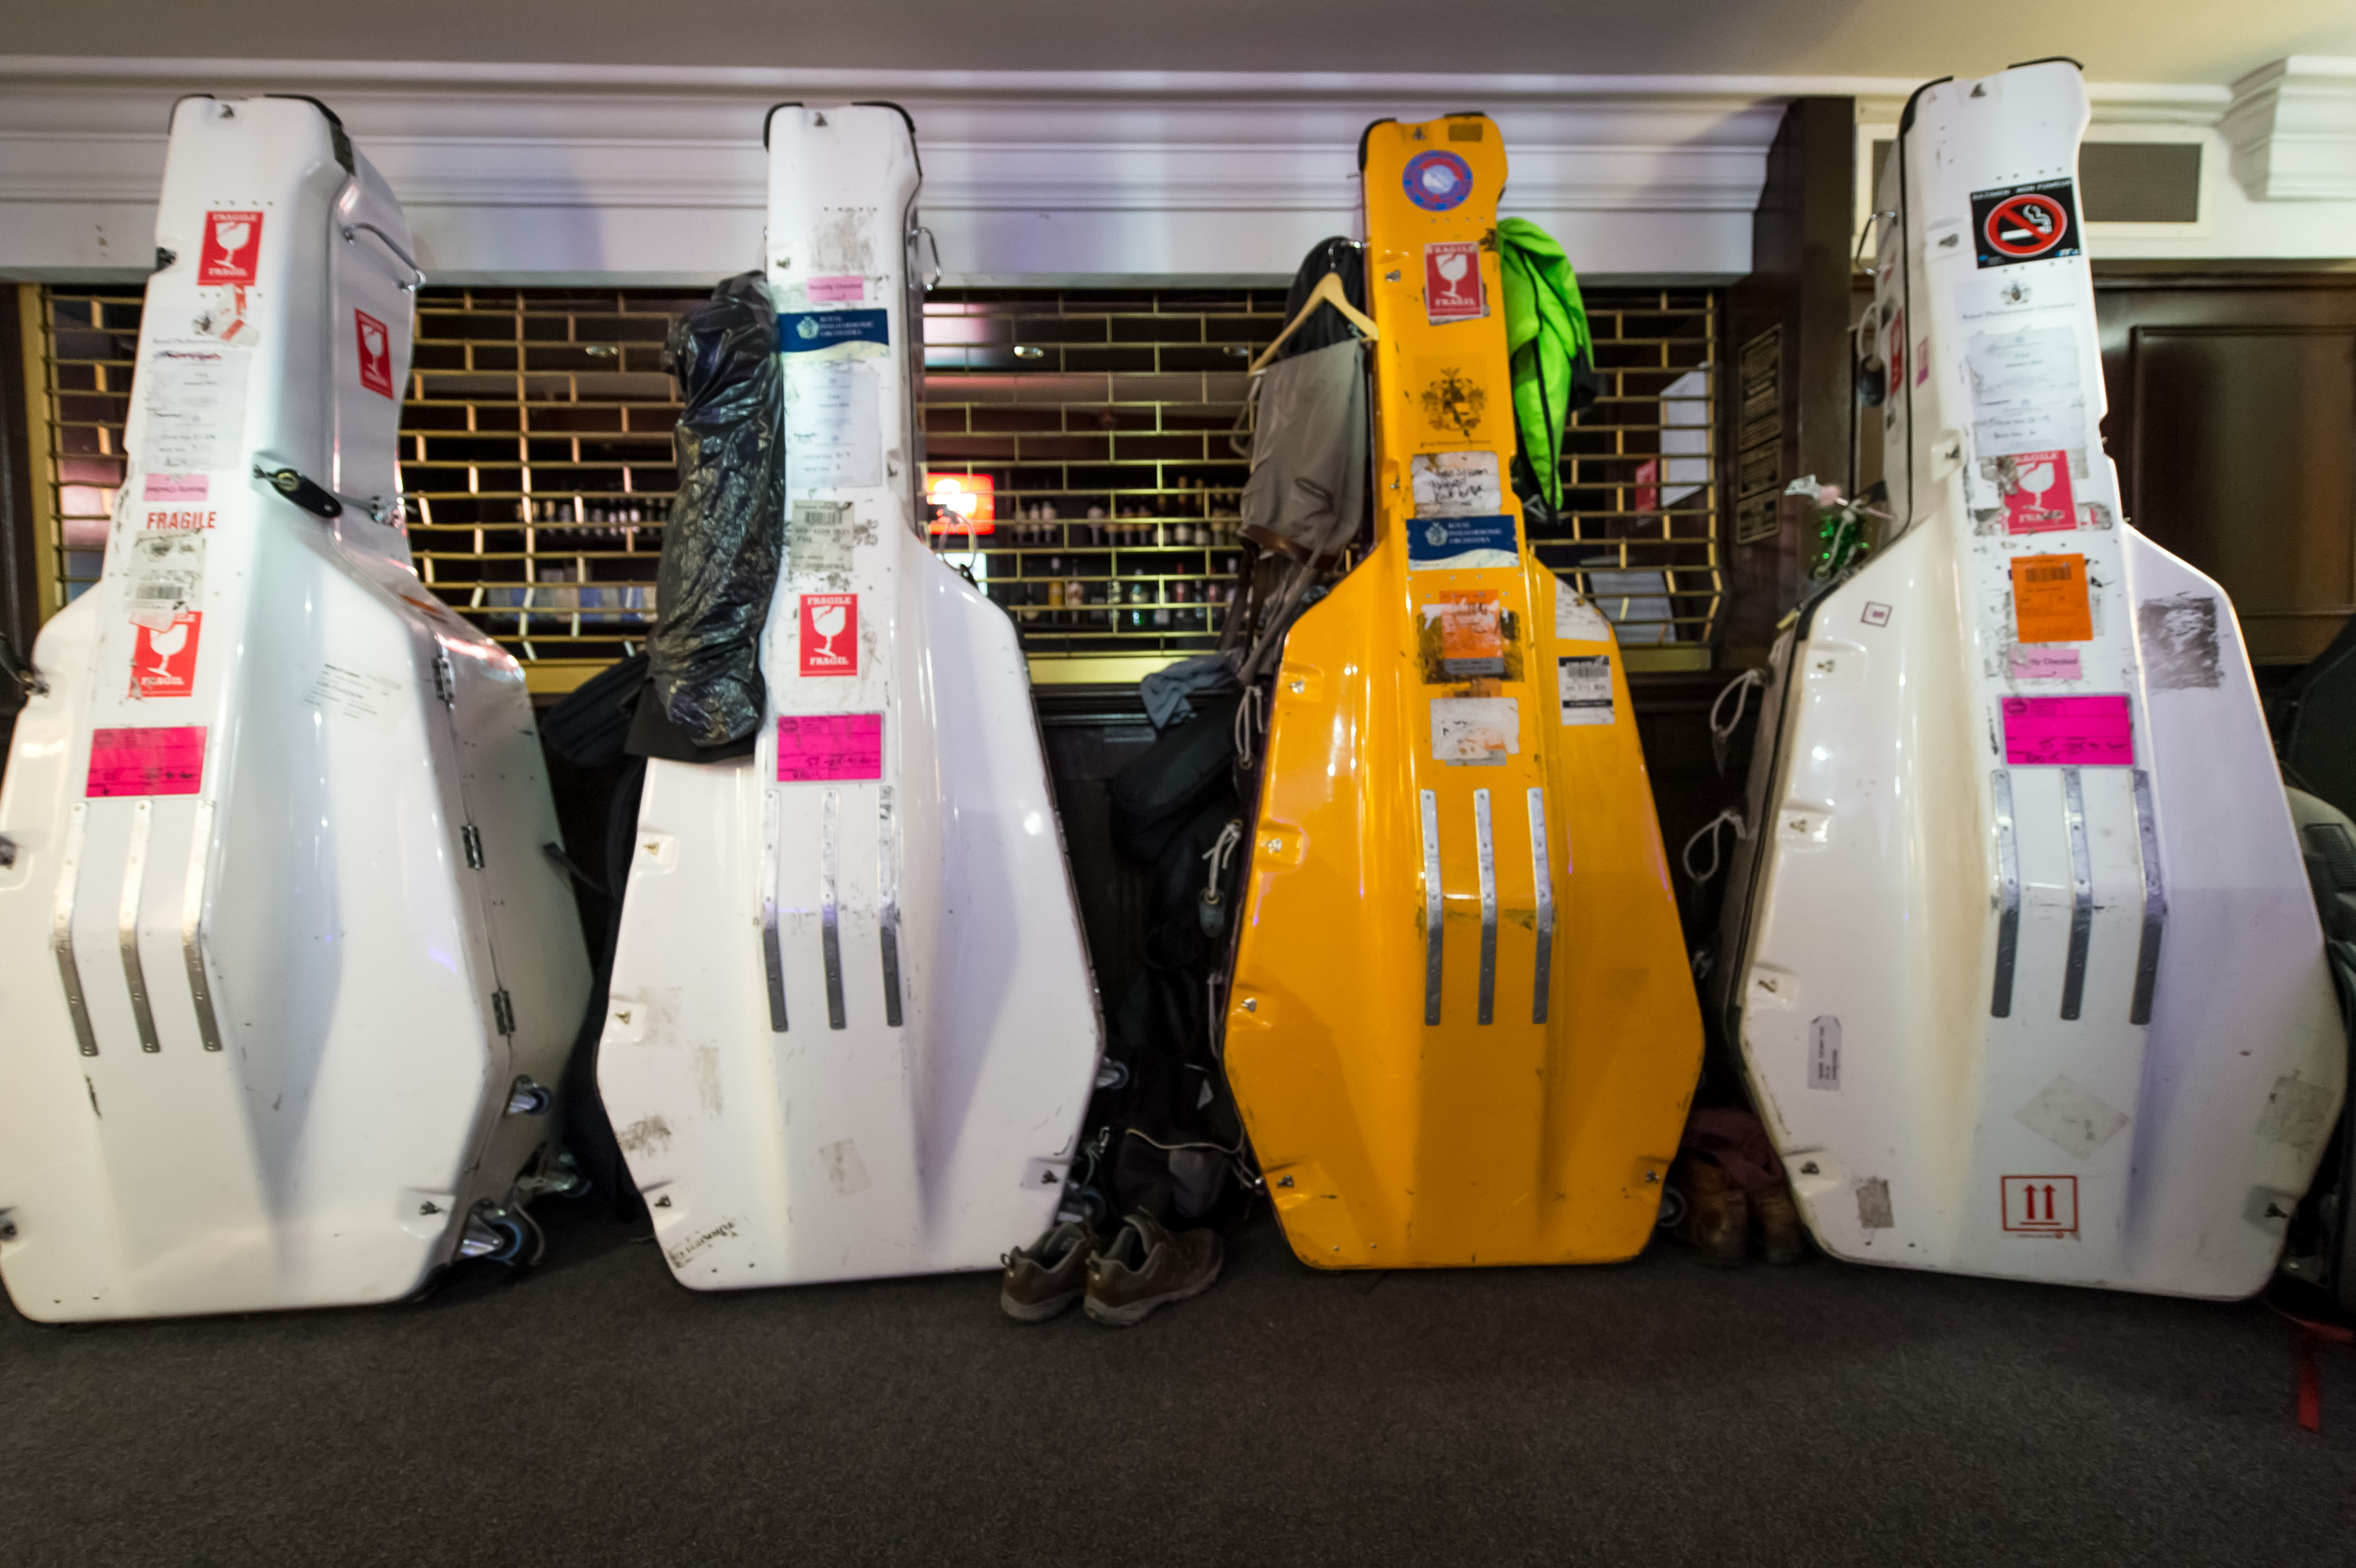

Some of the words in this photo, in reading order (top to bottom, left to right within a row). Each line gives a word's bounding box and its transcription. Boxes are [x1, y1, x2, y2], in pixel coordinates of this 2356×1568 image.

[147, 510, 217, 530] FRAGILE
[807, 596, 851, 605] FRAGILE
[810, 656, 850, 666] FRAGIL
